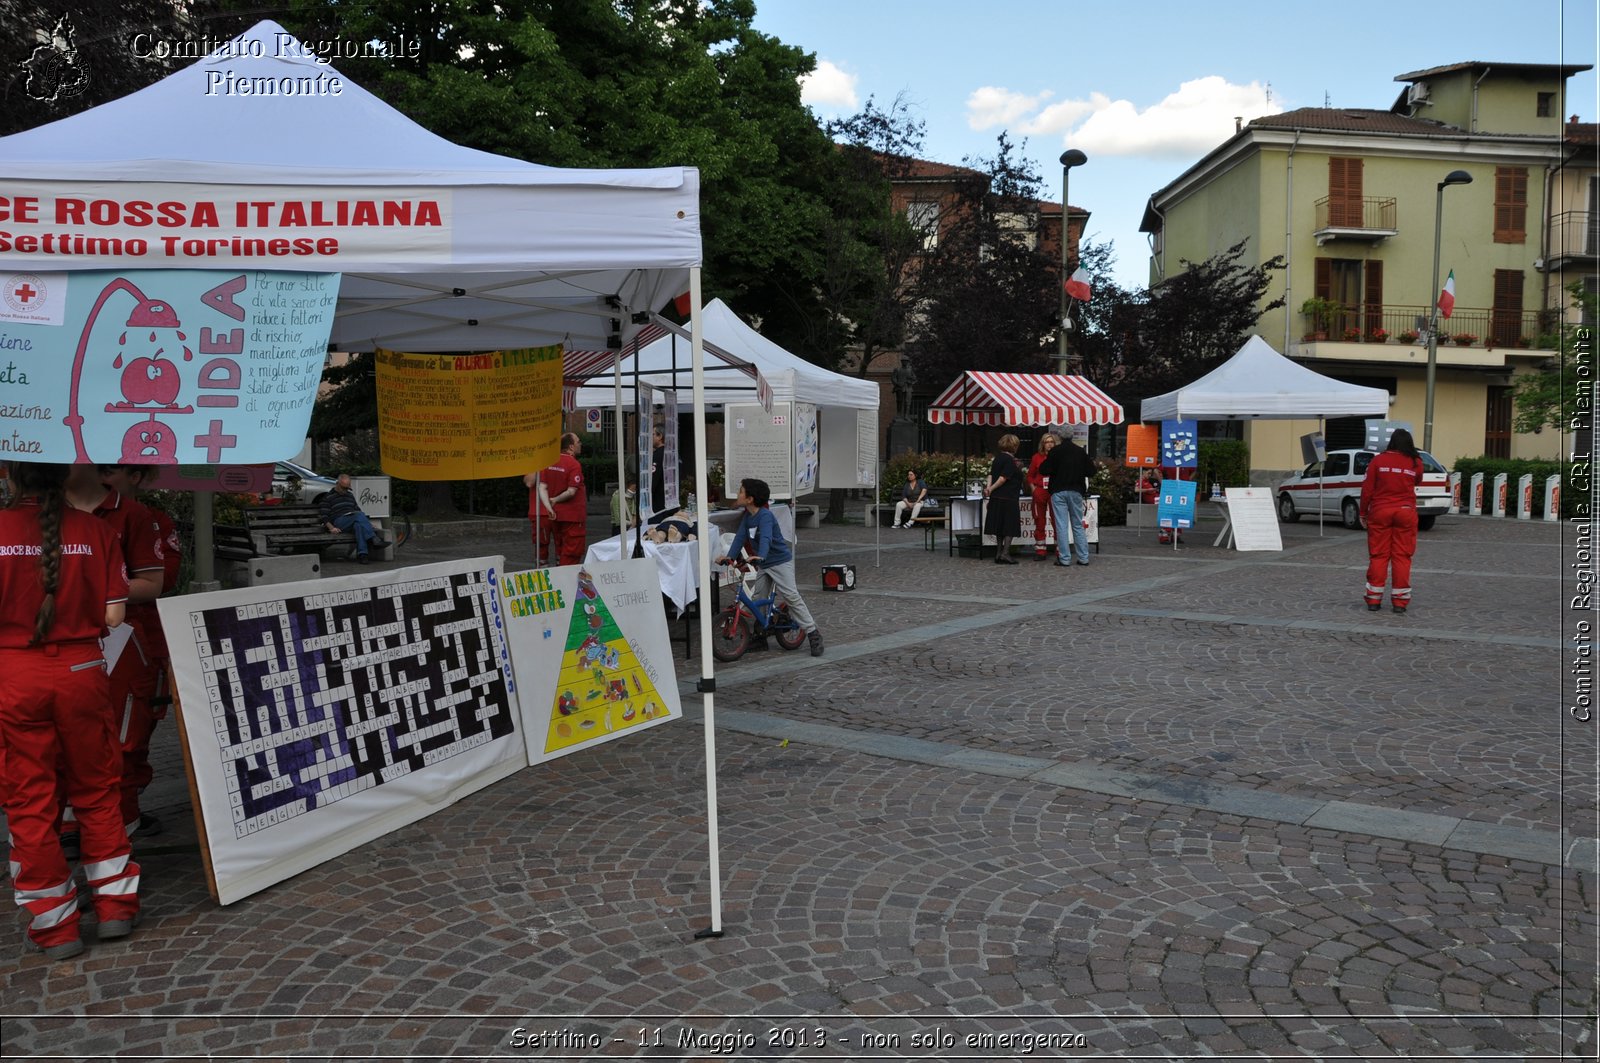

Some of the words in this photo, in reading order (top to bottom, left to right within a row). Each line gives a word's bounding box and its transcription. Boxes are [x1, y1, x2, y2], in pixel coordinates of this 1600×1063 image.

[55, 197, 220, 228] ROSSA
[235, 200, 442, 228] ITALIANA
[0, 231, 148, 257] Settimo
[161, 235, 339, 257] Torinese
[254, 272, 273, 290] Per
[276, 280, 296, 292] uno
[300, 273, 326, 291] stile
[252, 293, 265, 308] di
[269, 293, 288, 308] vita
[292, 298, 318, 309] sano
[252, 310, 280, 326] riduce
[290, 309, 324, 326] fattori
[250, 328, 263, 343] di
[259, 365, 300, 381] migliora
[247, 379, 273, 395] stato
[275, 380, 289, 394] di
[245, 397, 258, 413] di
